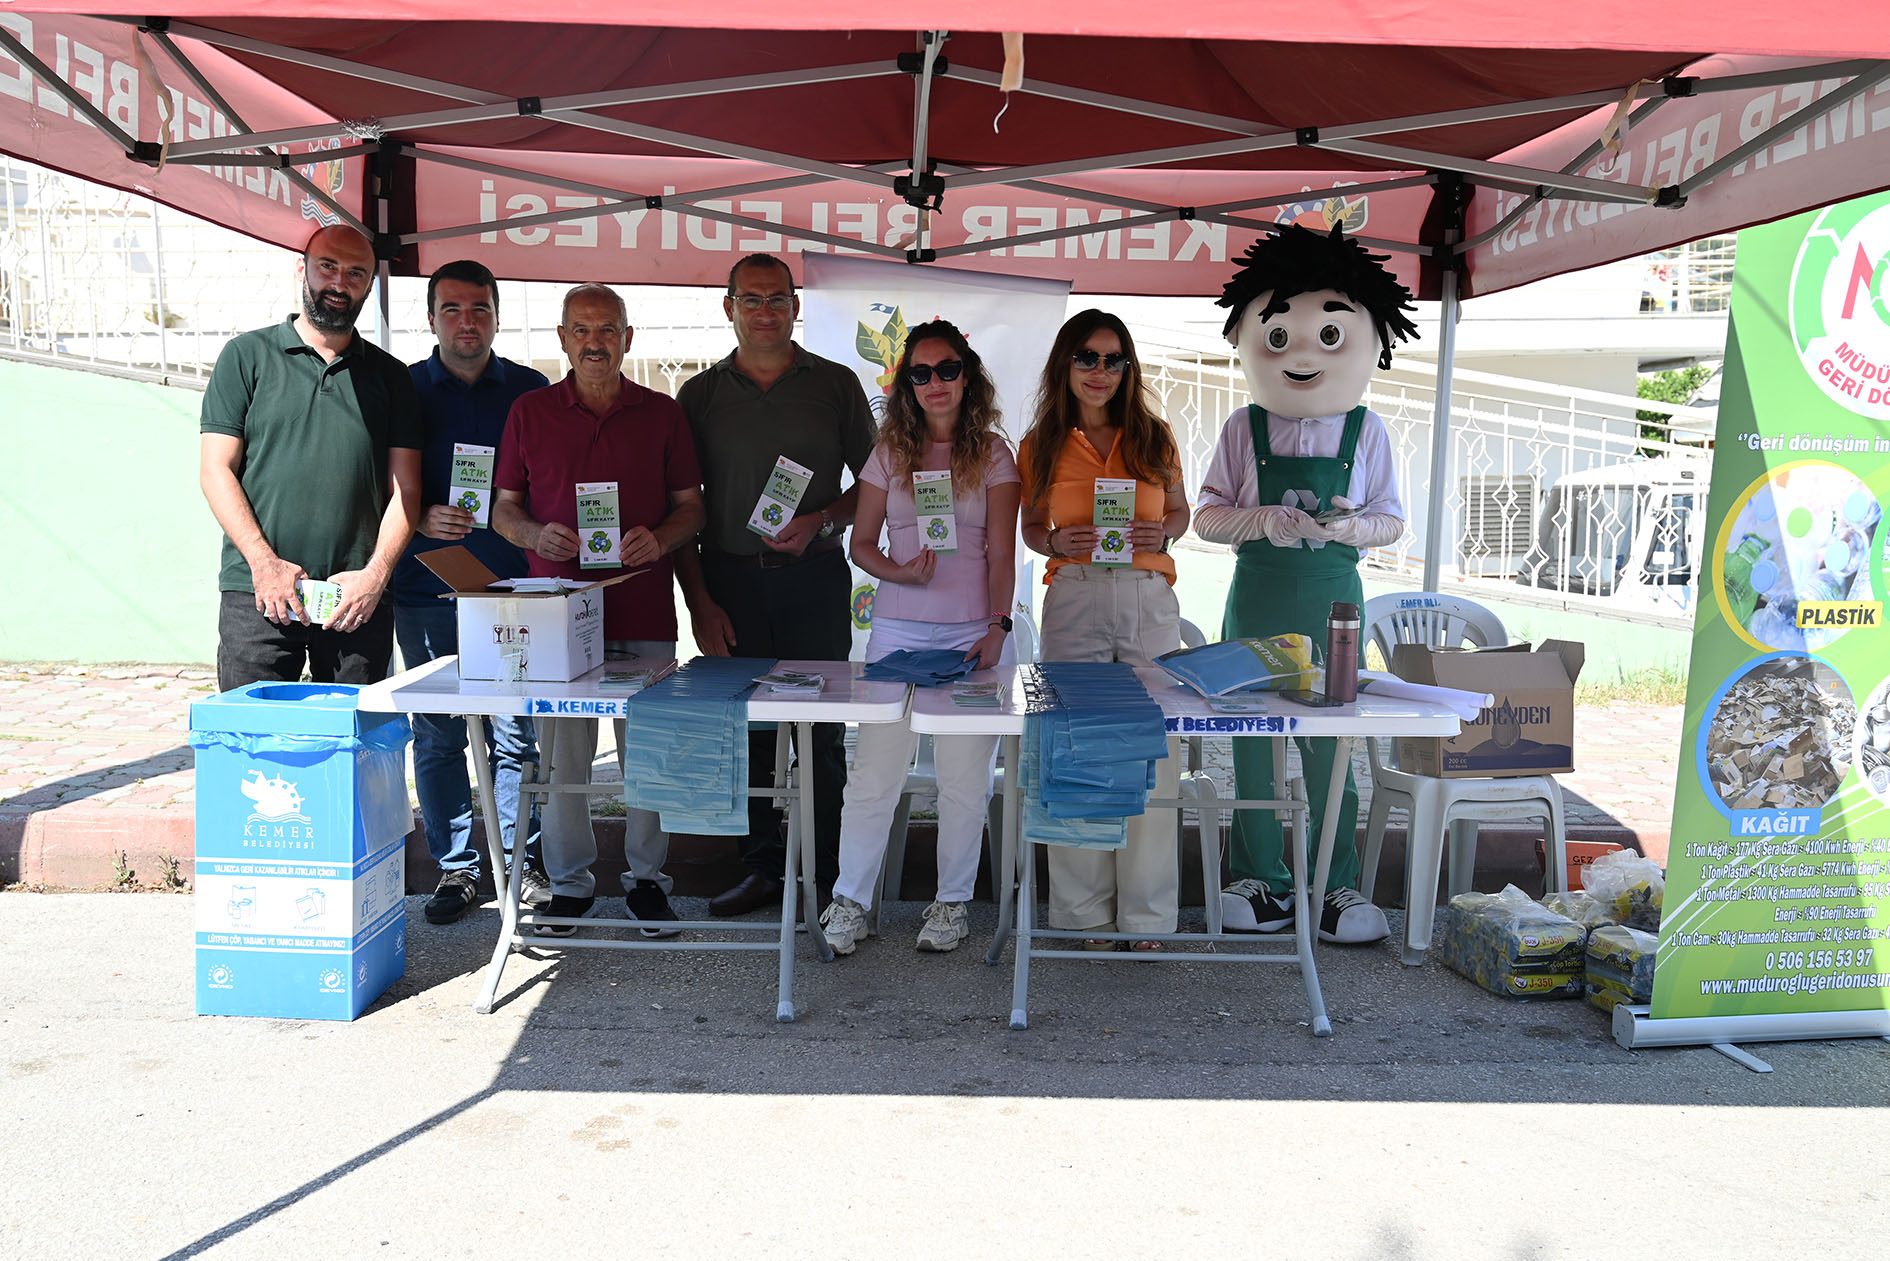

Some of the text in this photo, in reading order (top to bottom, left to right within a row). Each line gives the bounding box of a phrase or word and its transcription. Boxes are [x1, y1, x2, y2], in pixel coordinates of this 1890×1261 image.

[1818, 358, 1865, 399] GERİ
[1788, 433, 1869, 457] dönüşüm
[456, 460, 476, 468] SIFIR
[460, 468, 488, 478] ATIK
[775, 481, 800, 497] ATIK
[924, 494, 948, 502] ATIK
[586, 506, 614, 516] ATIK
[1103, 506, 1130, 516] ATIK
[322, 592, 334, 619] ATIK
[1801, 604, 1876, 625] PLASTİK
[1250, 640, 1283, 668] kemer
[558, 700, 617, 714] KEMER
[243, 824, 315, 839] KEMER
[1740, 811, 1810, 834] KAĞIT
[243, 840, 315, 850] BELEDİYESİ
[1685, 842, 1691, 857] 1
[1693, 842, 1706, 857] Ton
[1707, 840, 1728, 860] Kağıt
[1735, 841, 1750, 857] 177
[1763, 841, 1780, 857] Sera
[1781, 840, 1799, 856] Gazı
[1805, 840, 1824, 855] 4100
[1825, 839, 1841, 855] Kwh
[1842, 838, 1865, 857] Enerji
[1701, 863, 1706, 880] 1
[1708, 864, 1722, 879] Ton
[1722, 862, 1750, 879] Plastik
[1757, 862, 1767, 878] 41
[1768, 862, 1780, 881] Kg
[1779, 862, 1797, 878] Sera
[1798, 861, 1815, 877] Gazı
[1821, 860, 1840, 877] 5774
[1840, 860, 1857, 876] Kwh
[1857, 859, 1880, 879] Enerji
[1696, 886, 1702, 902] 1
[1703, 886, 1717, 901] Ton
[1718, 885, 1740, 901] Metal
[1747, 885, 1767, 900] 1300
[1767, 884, 1779, 903] Kg
[1779, 883, 1821, 899] Hammadde
[1821, 881, 1857, 898] Tasarrufu
[1775, 906, 1797, 924] Enerji
[1819, 904, 1843, 922] Enerji
[1842, 903, 1878, 919] Tasarrufu
[1541, 936, 1565, 945] J-350
[1671, 932, 1677, 947] 1
[1678, 932, 1692, 946] Ton
[1693, 931, 1710, 946] Cam
[1718, 930, 1737, 948] 30kg
[1737, 929, 1780, 945] Hammadde
[1780, 927, 1816, 943] Tasarrufu
[1822, 927, 1834, 942] 32
[1833, 927, 1845, 944] Kg
[1844, 926, 1861, 941] Sera
[1862, 925, 1879, 940] Gazı
[1765, 948, 1873, 971] 0 506 156 53 97
[1530, 978, 1553, 988] J-350
